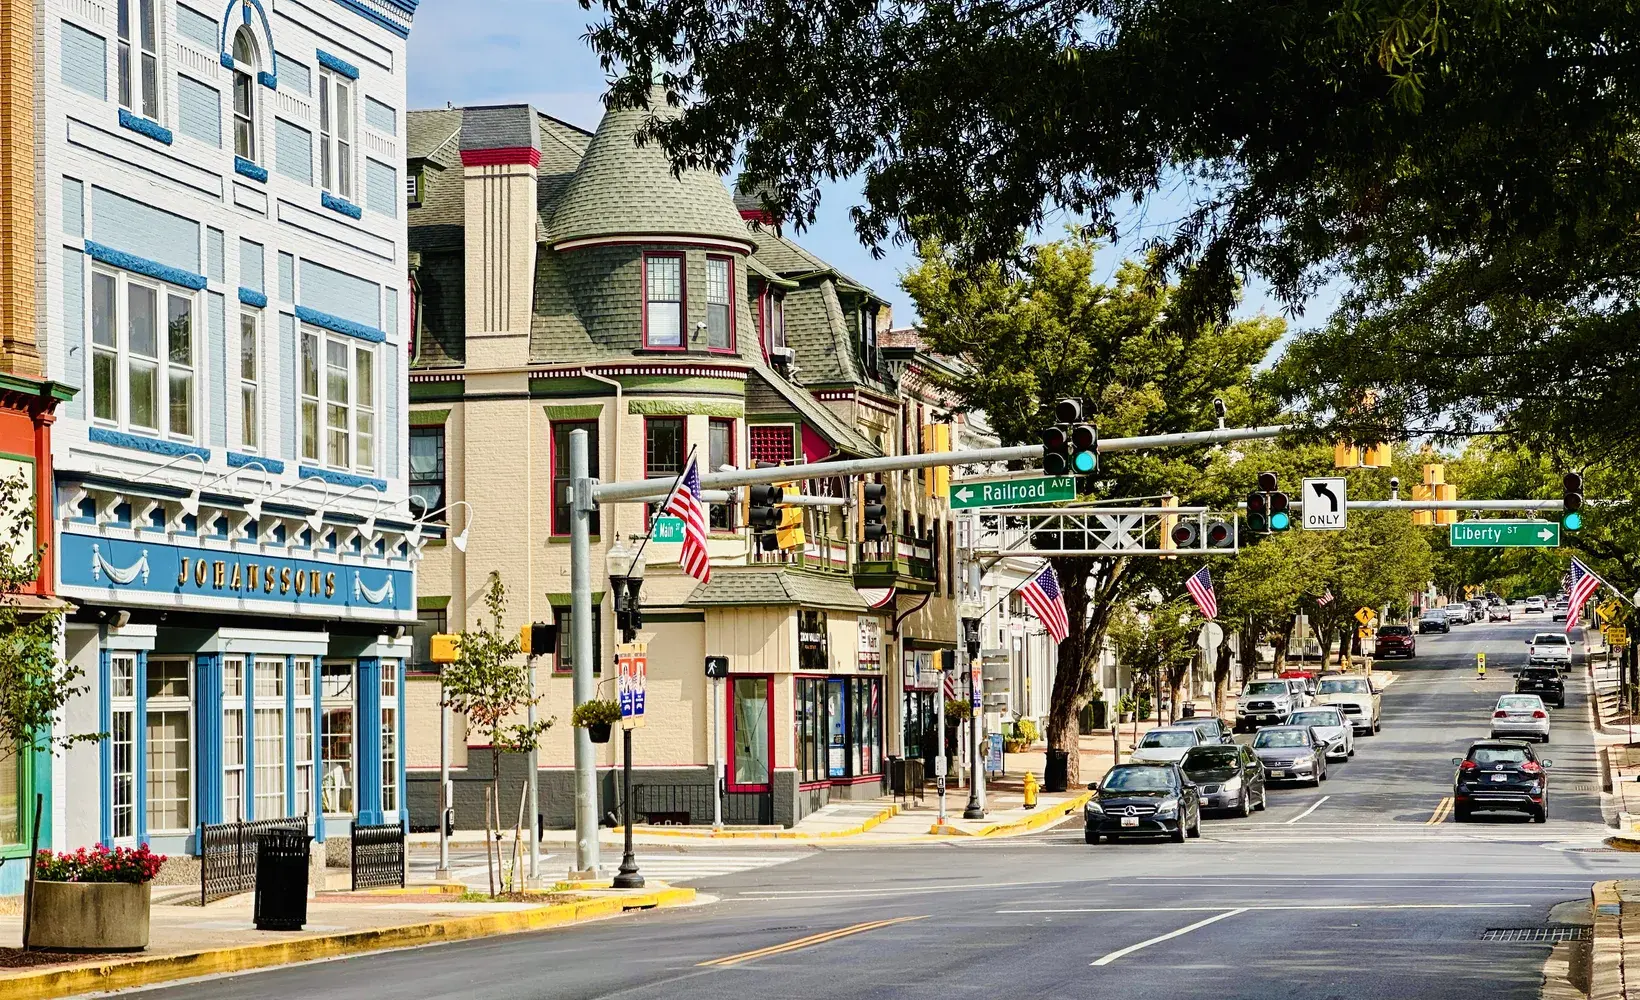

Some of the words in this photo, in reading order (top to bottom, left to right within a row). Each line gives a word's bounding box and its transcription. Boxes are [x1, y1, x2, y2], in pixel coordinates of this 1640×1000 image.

[983, 481, 1045, 501] Railroad
[1051, 478, 1071, 488] AVE
[1309, 514, 1340, 525] ONLY
[659, 522, 674, 538] Main
[1454, 526, 1502, 543] Liberty
[1507, 526, 1518, 534] ST
[178, 556, 336, 598] JOHANSSONS
